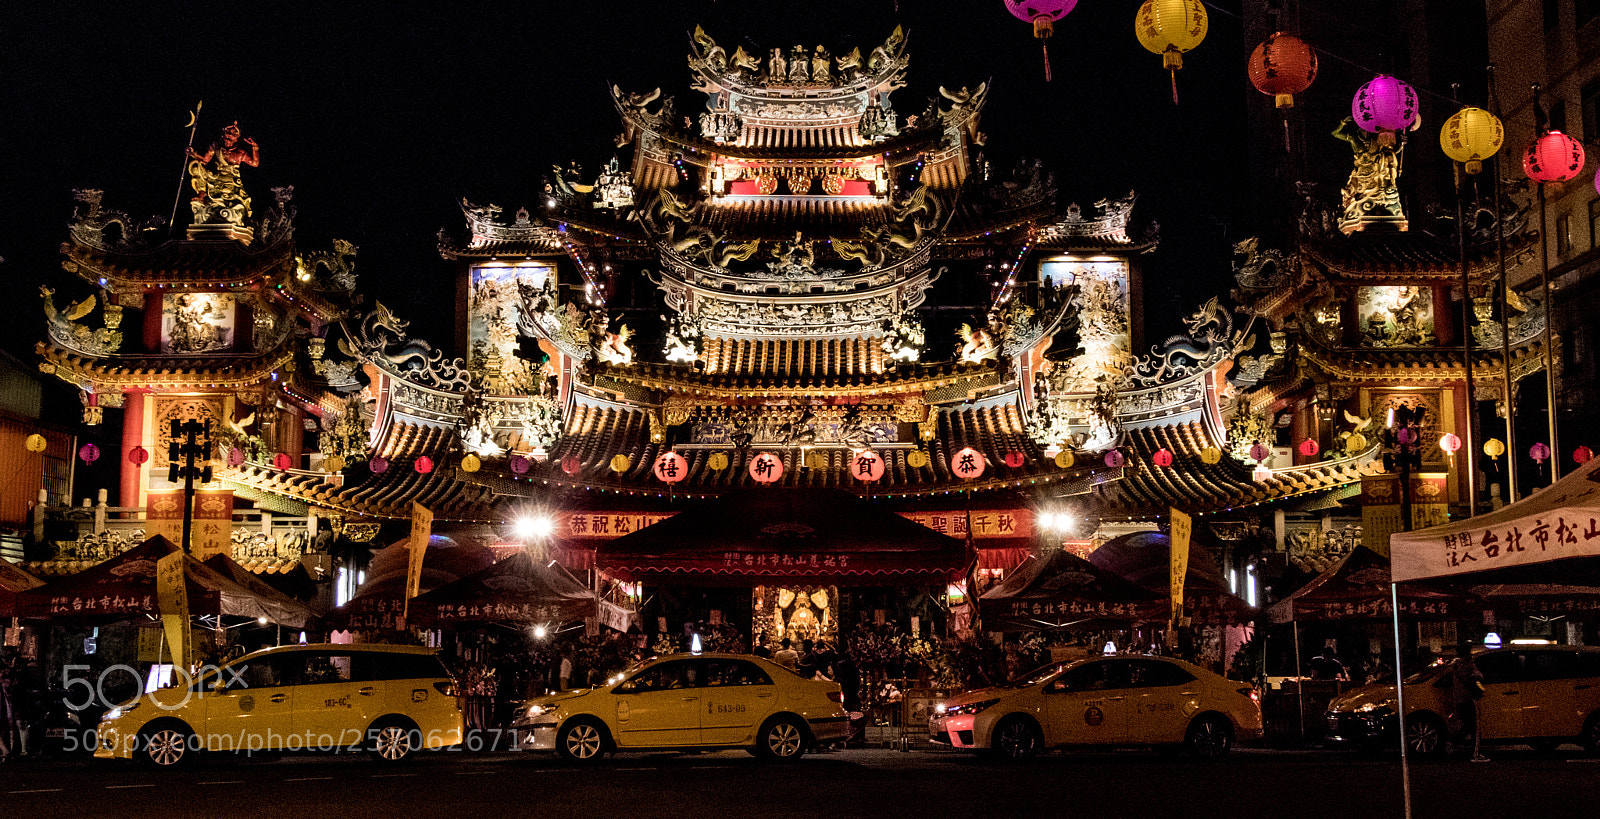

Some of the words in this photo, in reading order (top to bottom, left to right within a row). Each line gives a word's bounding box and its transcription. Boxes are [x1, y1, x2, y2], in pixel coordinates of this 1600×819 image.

[1189, 0, 1203, 37] 上聖母
[658, 458, 679, 478] 禧
[754, 458, 775, 478] 新
[856, 457, 876, 477] 賀
[958, 454, 977, 473] 恭
[571, 515, 666, 534] 恭祝松山
[1480, 516, 1600, 559] 台北市松山
